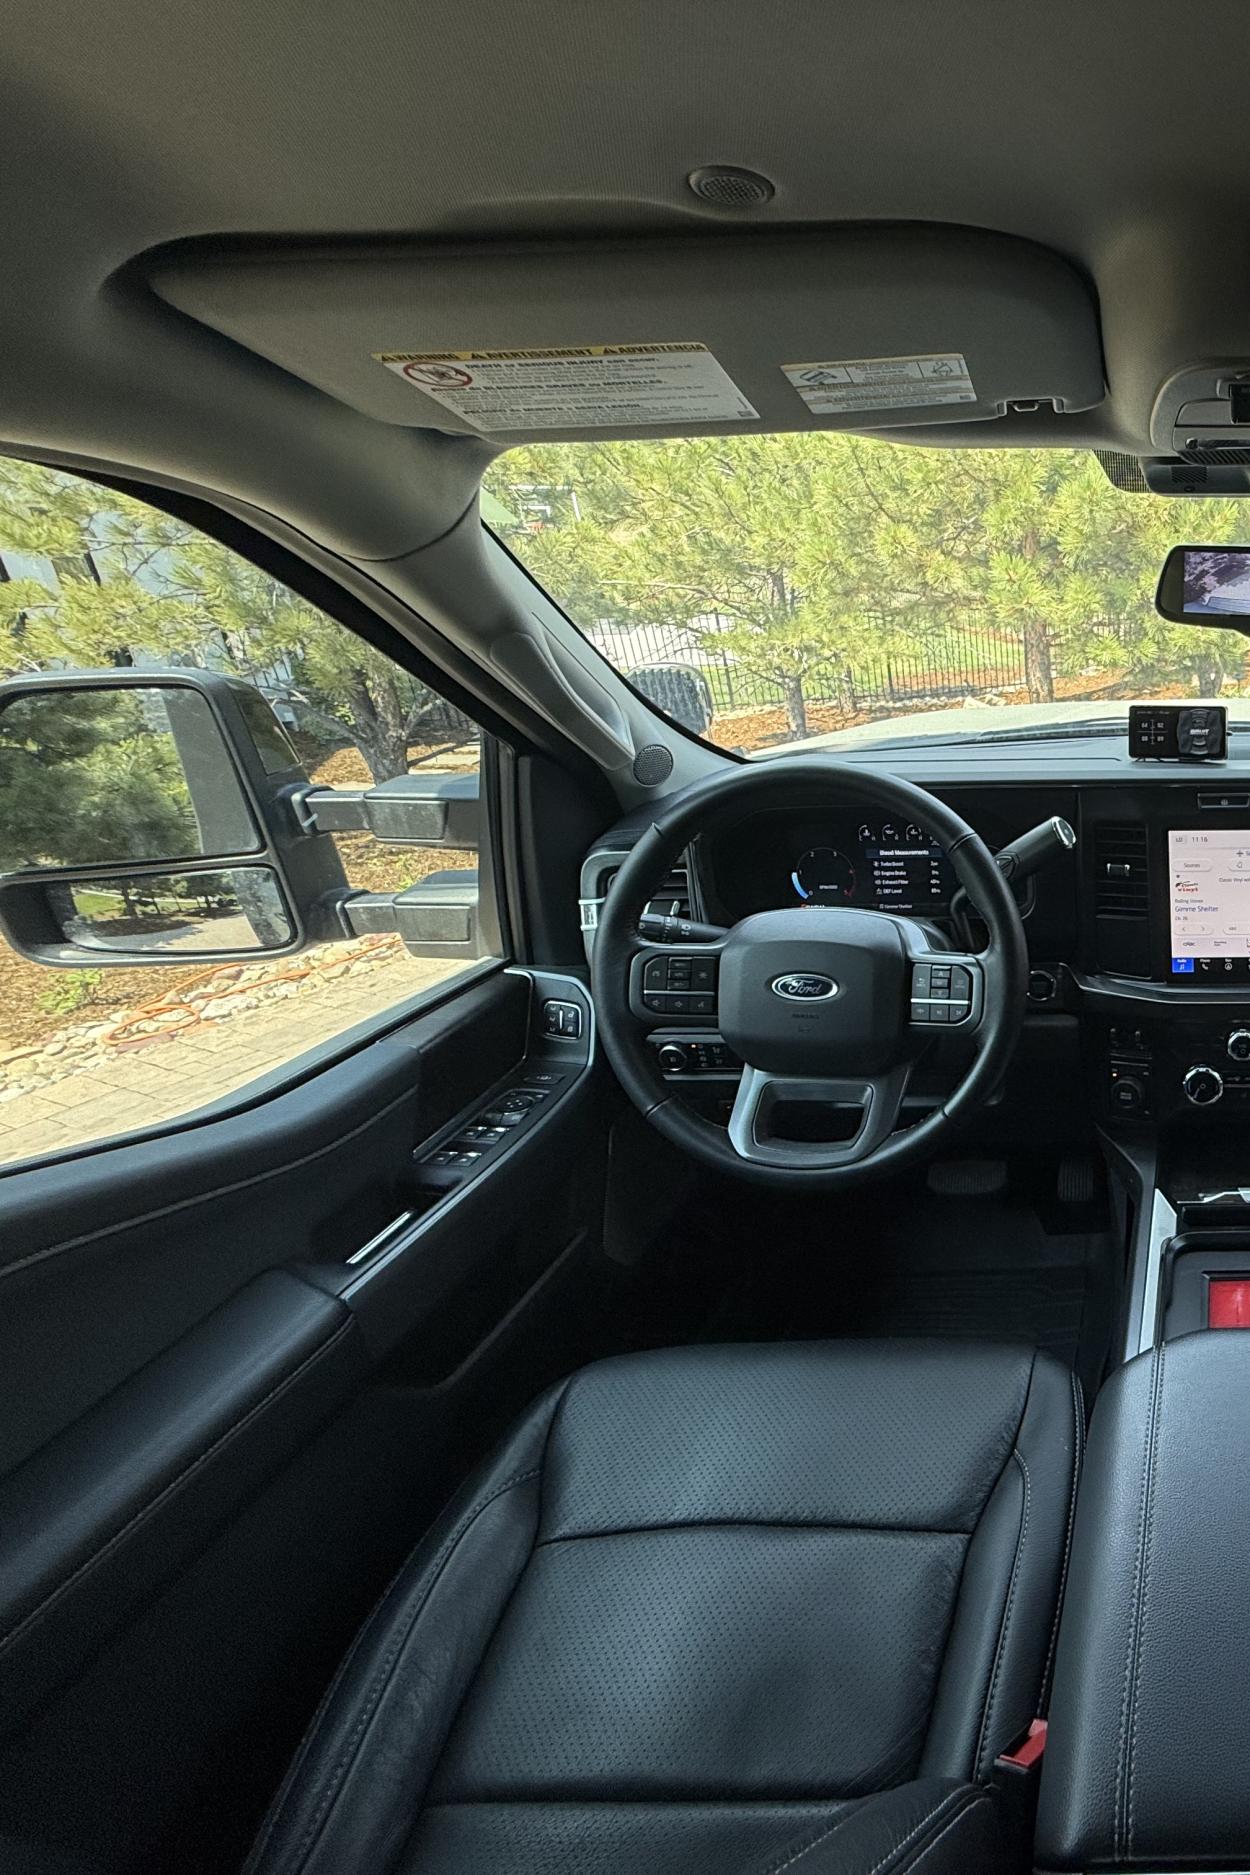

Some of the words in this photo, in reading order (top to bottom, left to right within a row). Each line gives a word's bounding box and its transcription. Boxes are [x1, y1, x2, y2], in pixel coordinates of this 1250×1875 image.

[485, 348, 593, 360] AVERTISSEMENT
[618, 343, 706, 354] ADVERTENCIA
[395, 352, 459, 361] WARNING
[1174, 905, 1196, 913] Gimme
[1197, 905, 1219, 913] Shelter
[784, 979, 822, 995] Ford
